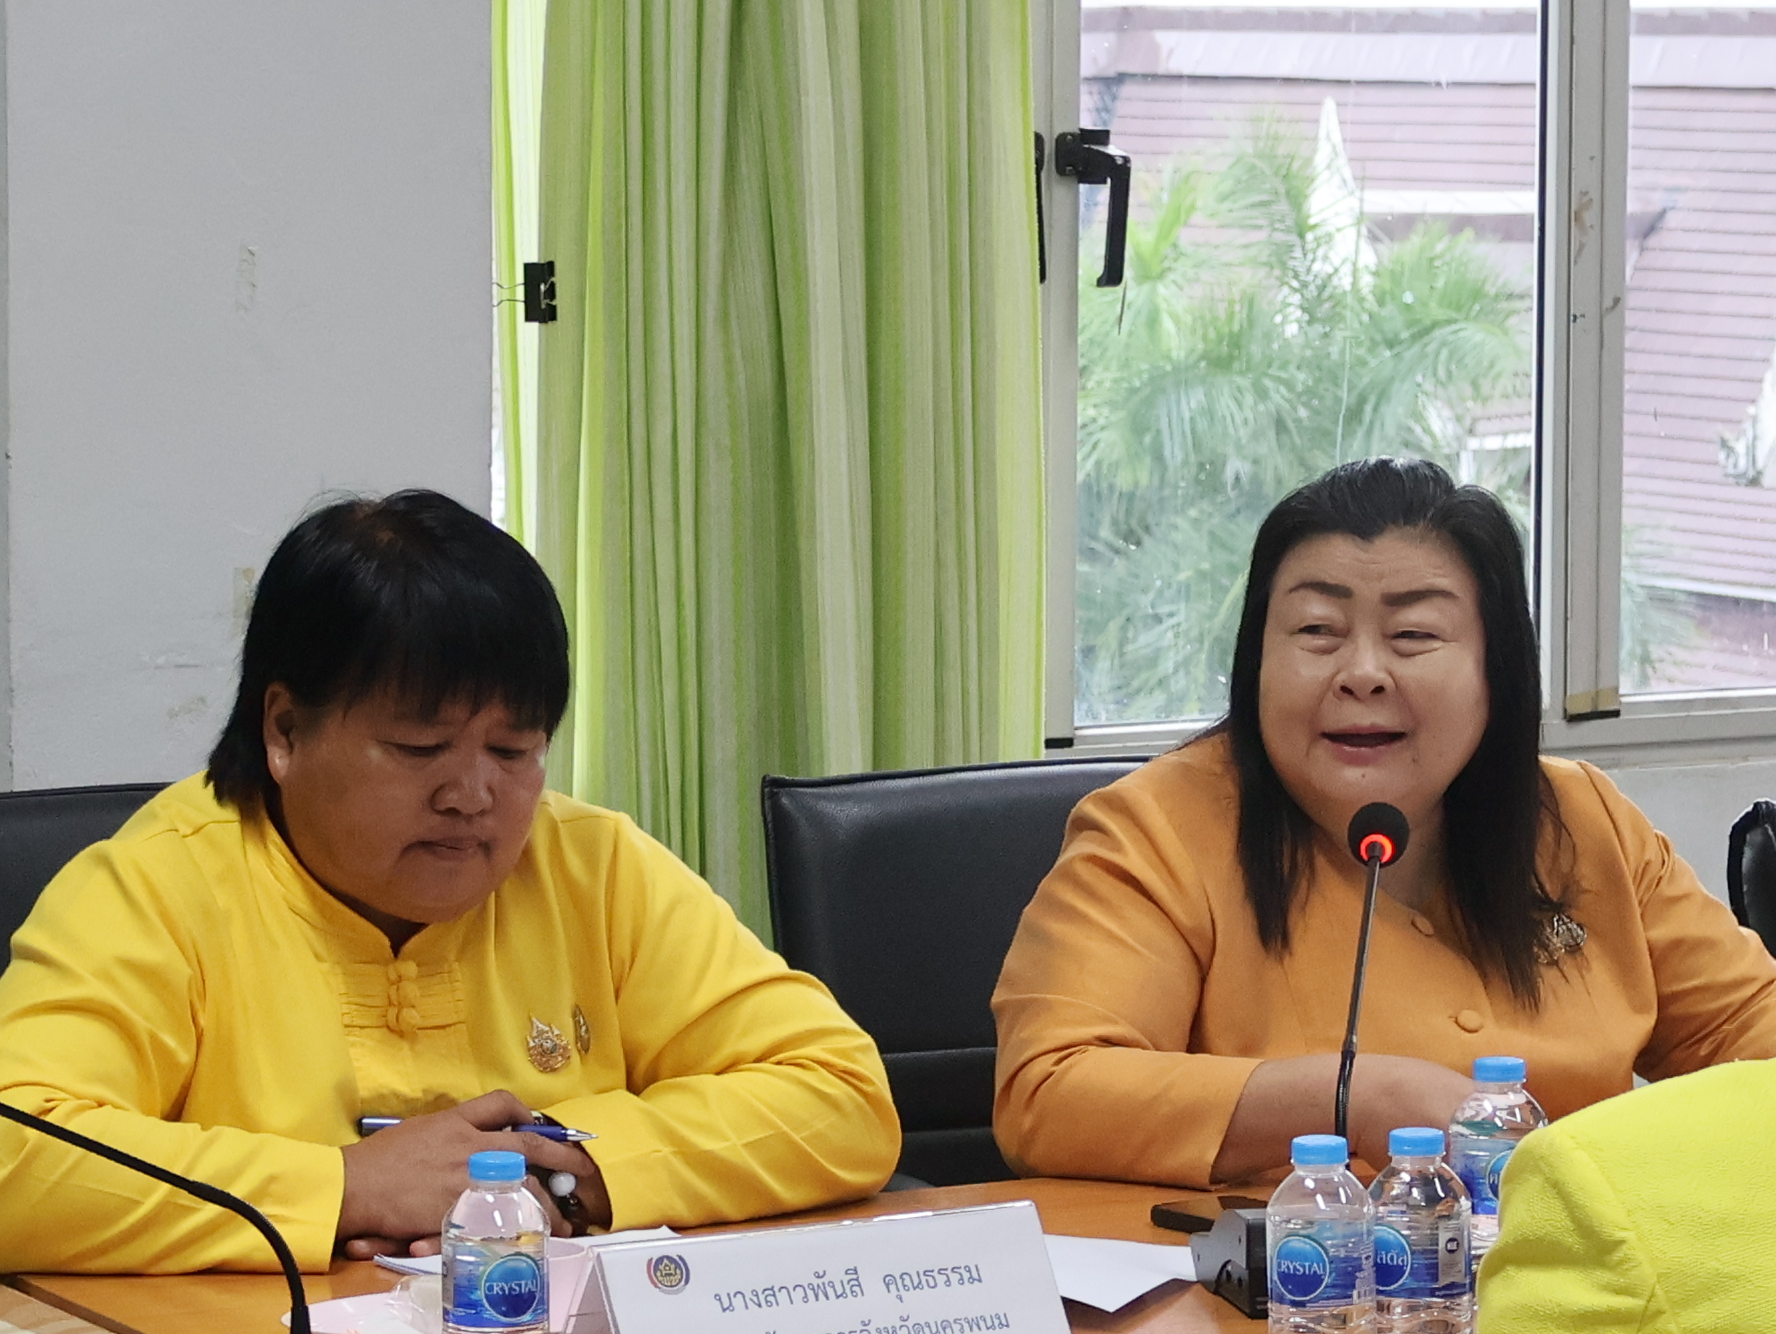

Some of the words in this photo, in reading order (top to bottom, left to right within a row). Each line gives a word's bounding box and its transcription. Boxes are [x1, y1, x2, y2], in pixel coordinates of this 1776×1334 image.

[1277, 1258, 1326, 1276] CRYSTAL
[484, 1280, 539, 1297] CRYSTAL
[713, 1265, 865, 1314] นางสาวพันสี
[882, 1261, 983, 1304] คุณธรรม
